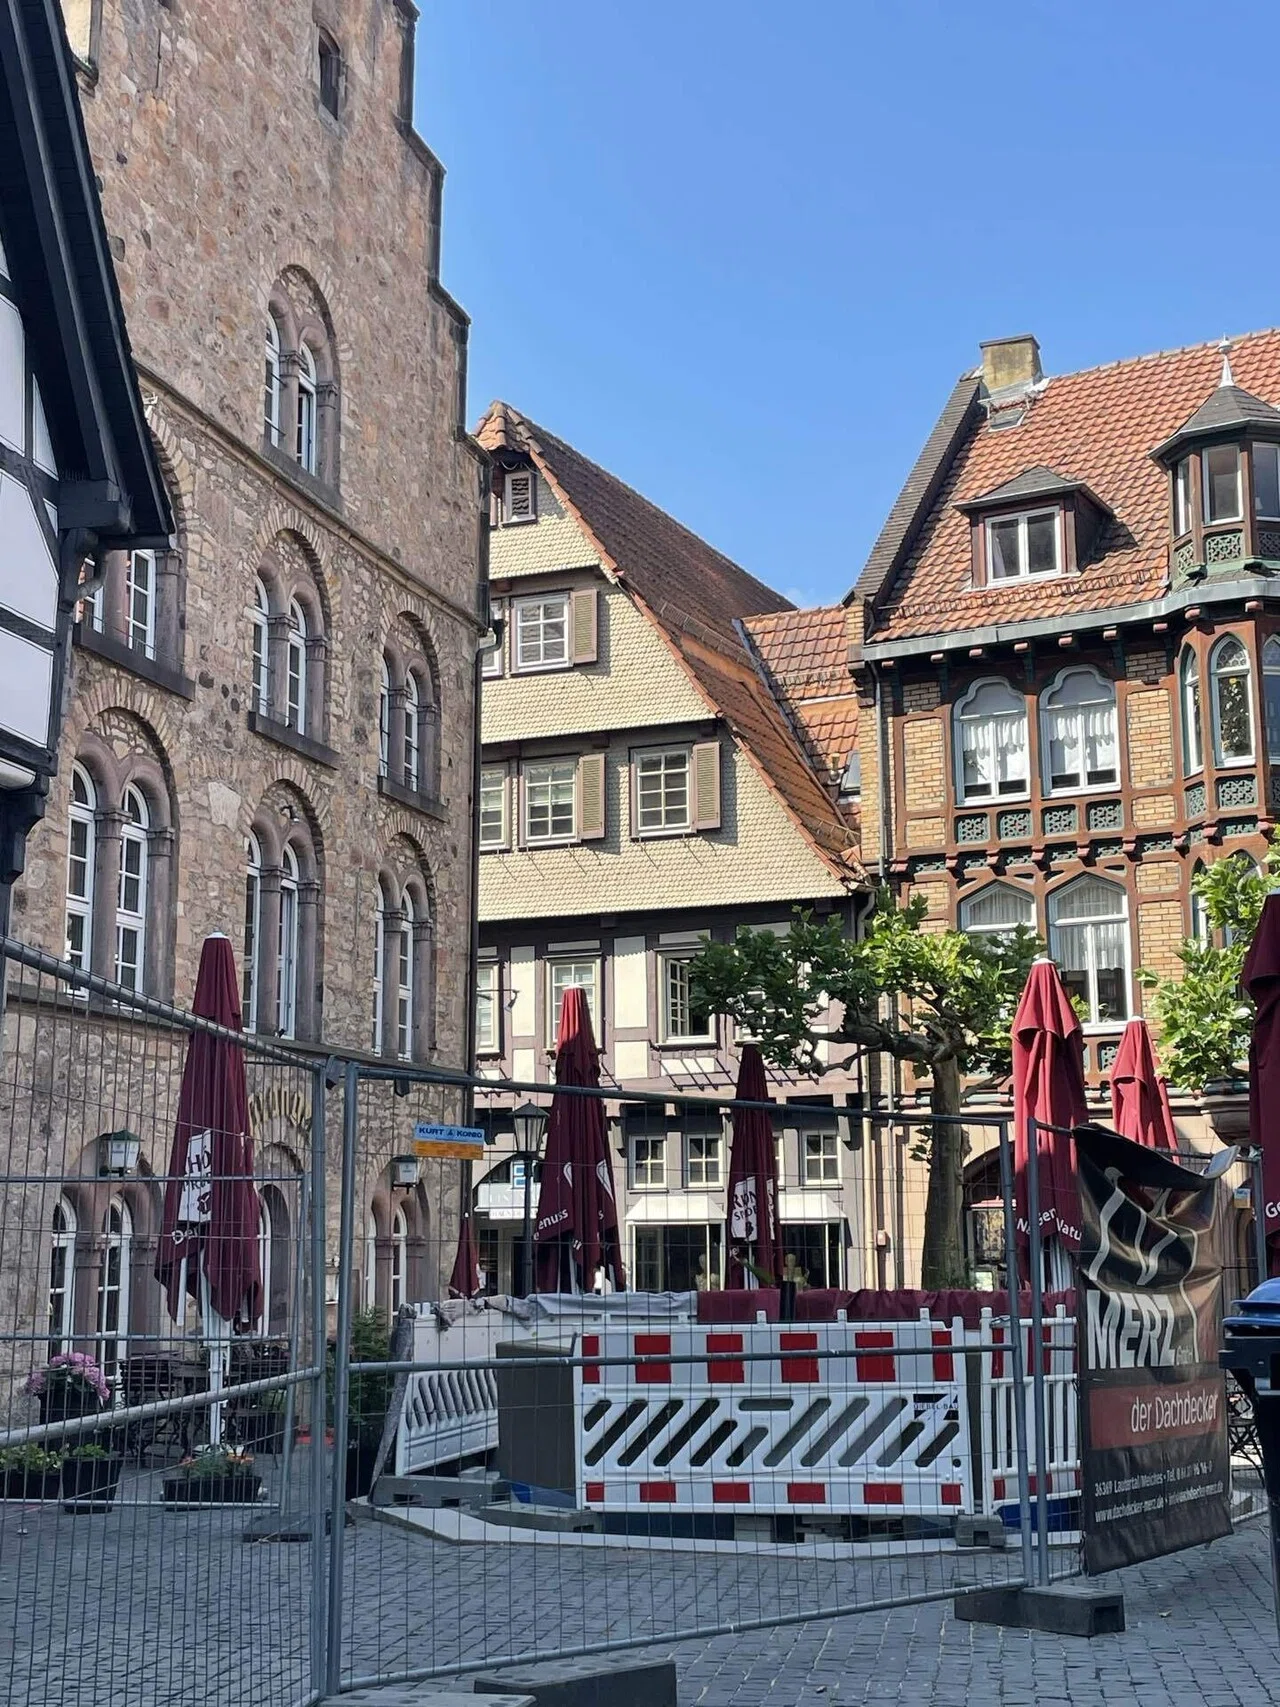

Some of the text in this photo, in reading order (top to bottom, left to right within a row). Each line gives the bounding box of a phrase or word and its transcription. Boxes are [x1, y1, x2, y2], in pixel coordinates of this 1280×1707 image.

[419, 1127, 445, 1136] KURT
[538, 1208, 569, 1230] enuss
[1086, 1289, 1176, 1370] MERZ
[1131, 1388, 1219, 1433] der Dachdecker
